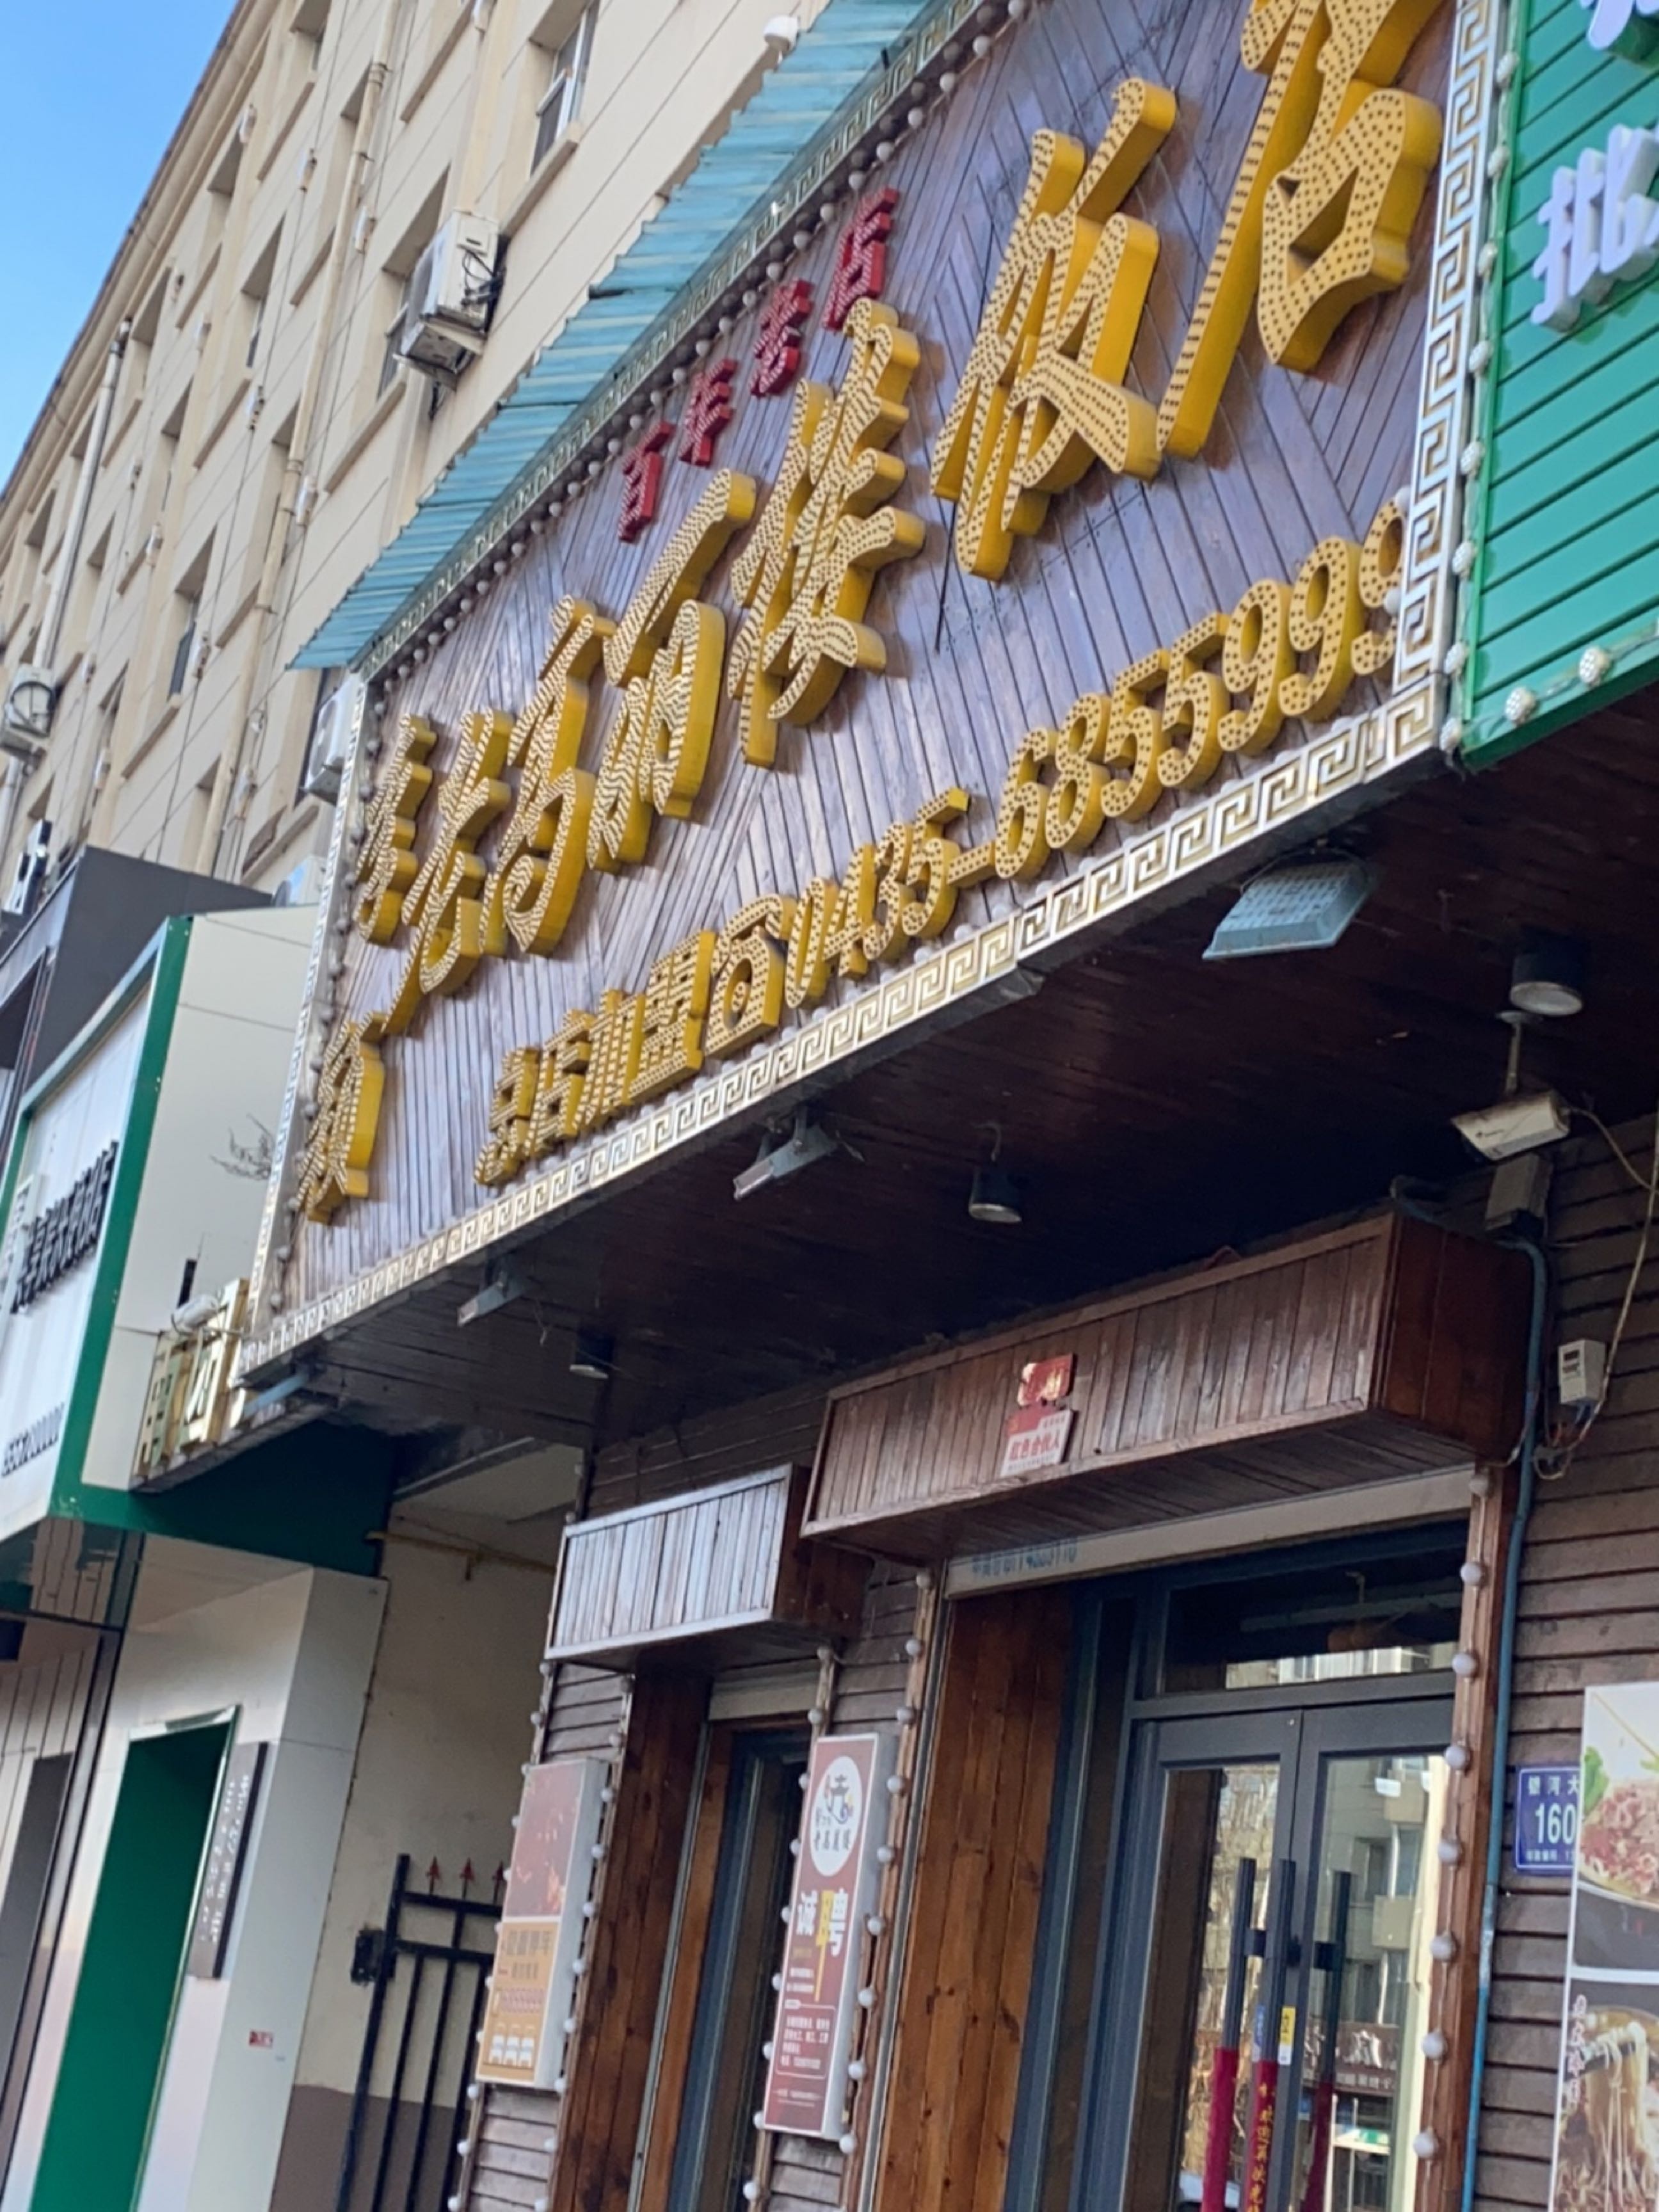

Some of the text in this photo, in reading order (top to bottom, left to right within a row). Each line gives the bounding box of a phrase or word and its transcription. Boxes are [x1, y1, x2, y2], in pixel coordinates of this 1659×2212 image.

[617, 187, 899, 543] 百年老店
[1530, 124, 1659, 333] 批
[474, 496, 1407, 1186] 总店加盟 0435-6855999
[1535, 1802, 1576, 1844] 160
